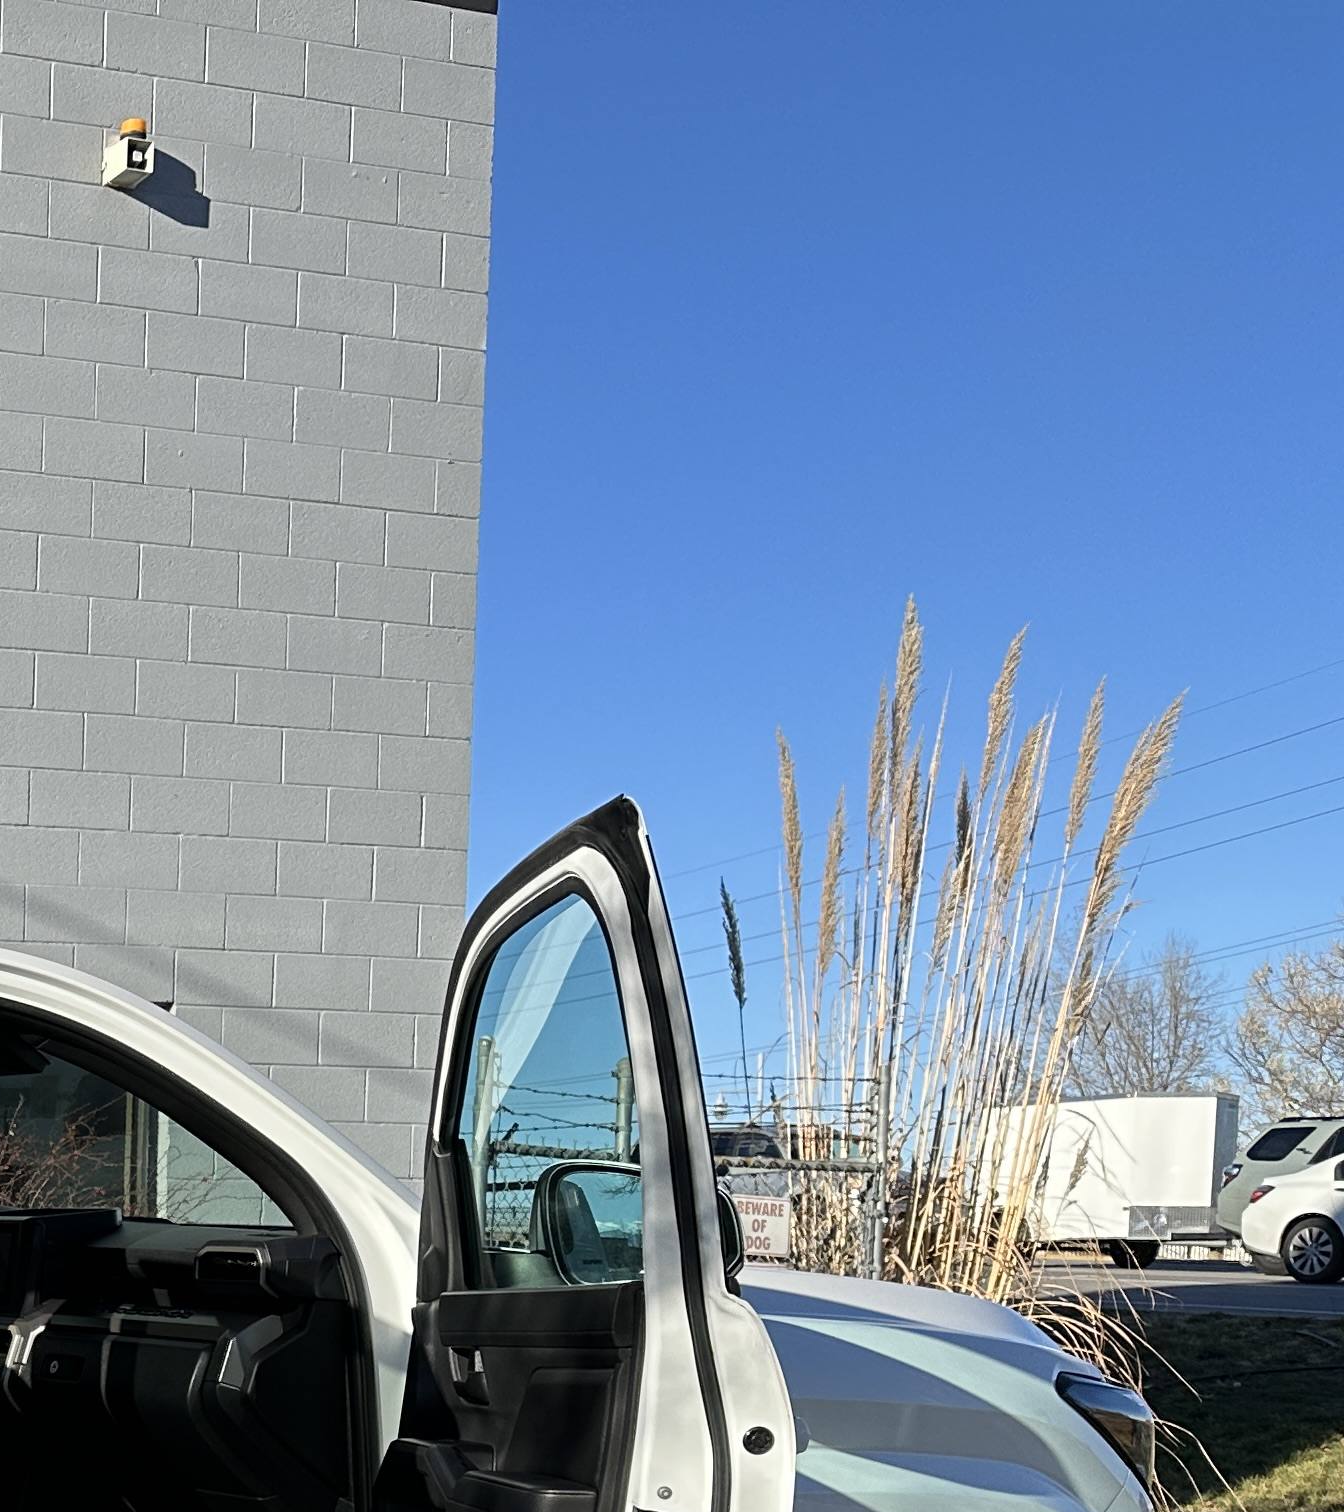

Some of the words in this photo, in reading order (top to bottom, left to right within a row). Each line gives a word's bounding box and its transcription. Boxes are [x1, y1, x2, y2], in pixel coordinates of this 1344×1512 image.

[737, 1200, 785, 1217] BEWARE
[752, 1218, 768, 1233] OF
[745, 1235, 771, 1251] DOG
